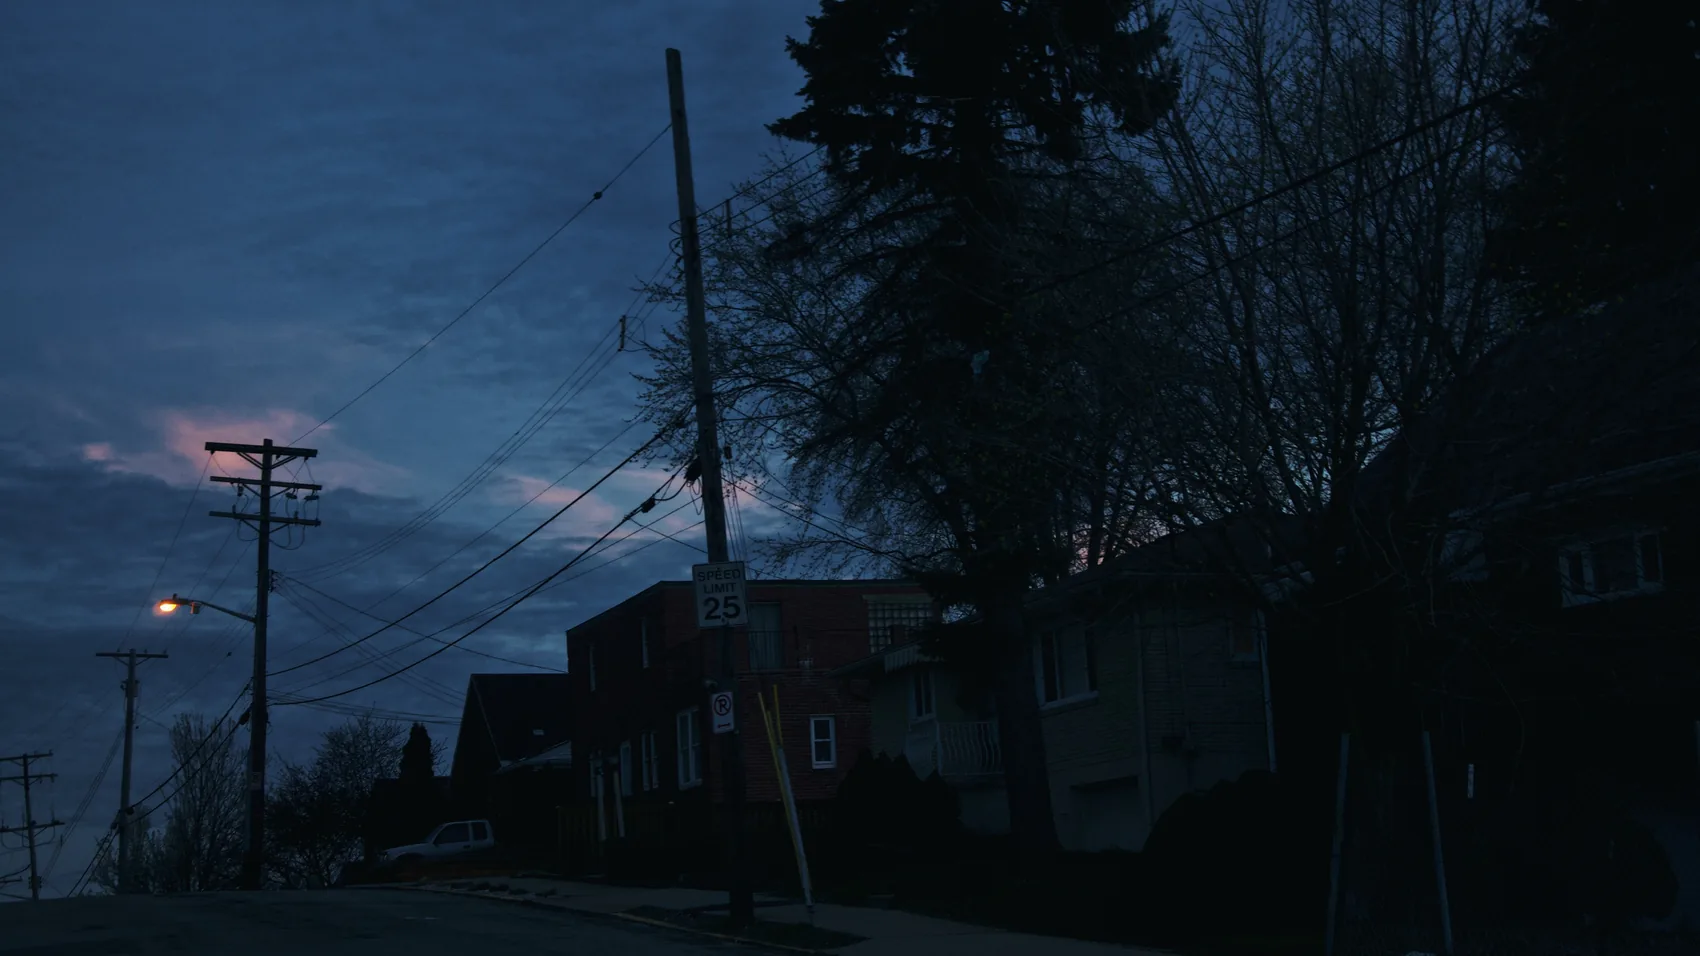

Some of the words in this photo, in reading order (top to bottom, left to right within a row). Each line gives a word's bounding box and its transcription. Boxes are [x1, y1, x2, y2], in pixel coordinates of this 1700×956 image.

[697, 569, 740, 581] SPEED
[703, 583, 736, 594] LIMIT
[703, 595, 741, 620] 25
